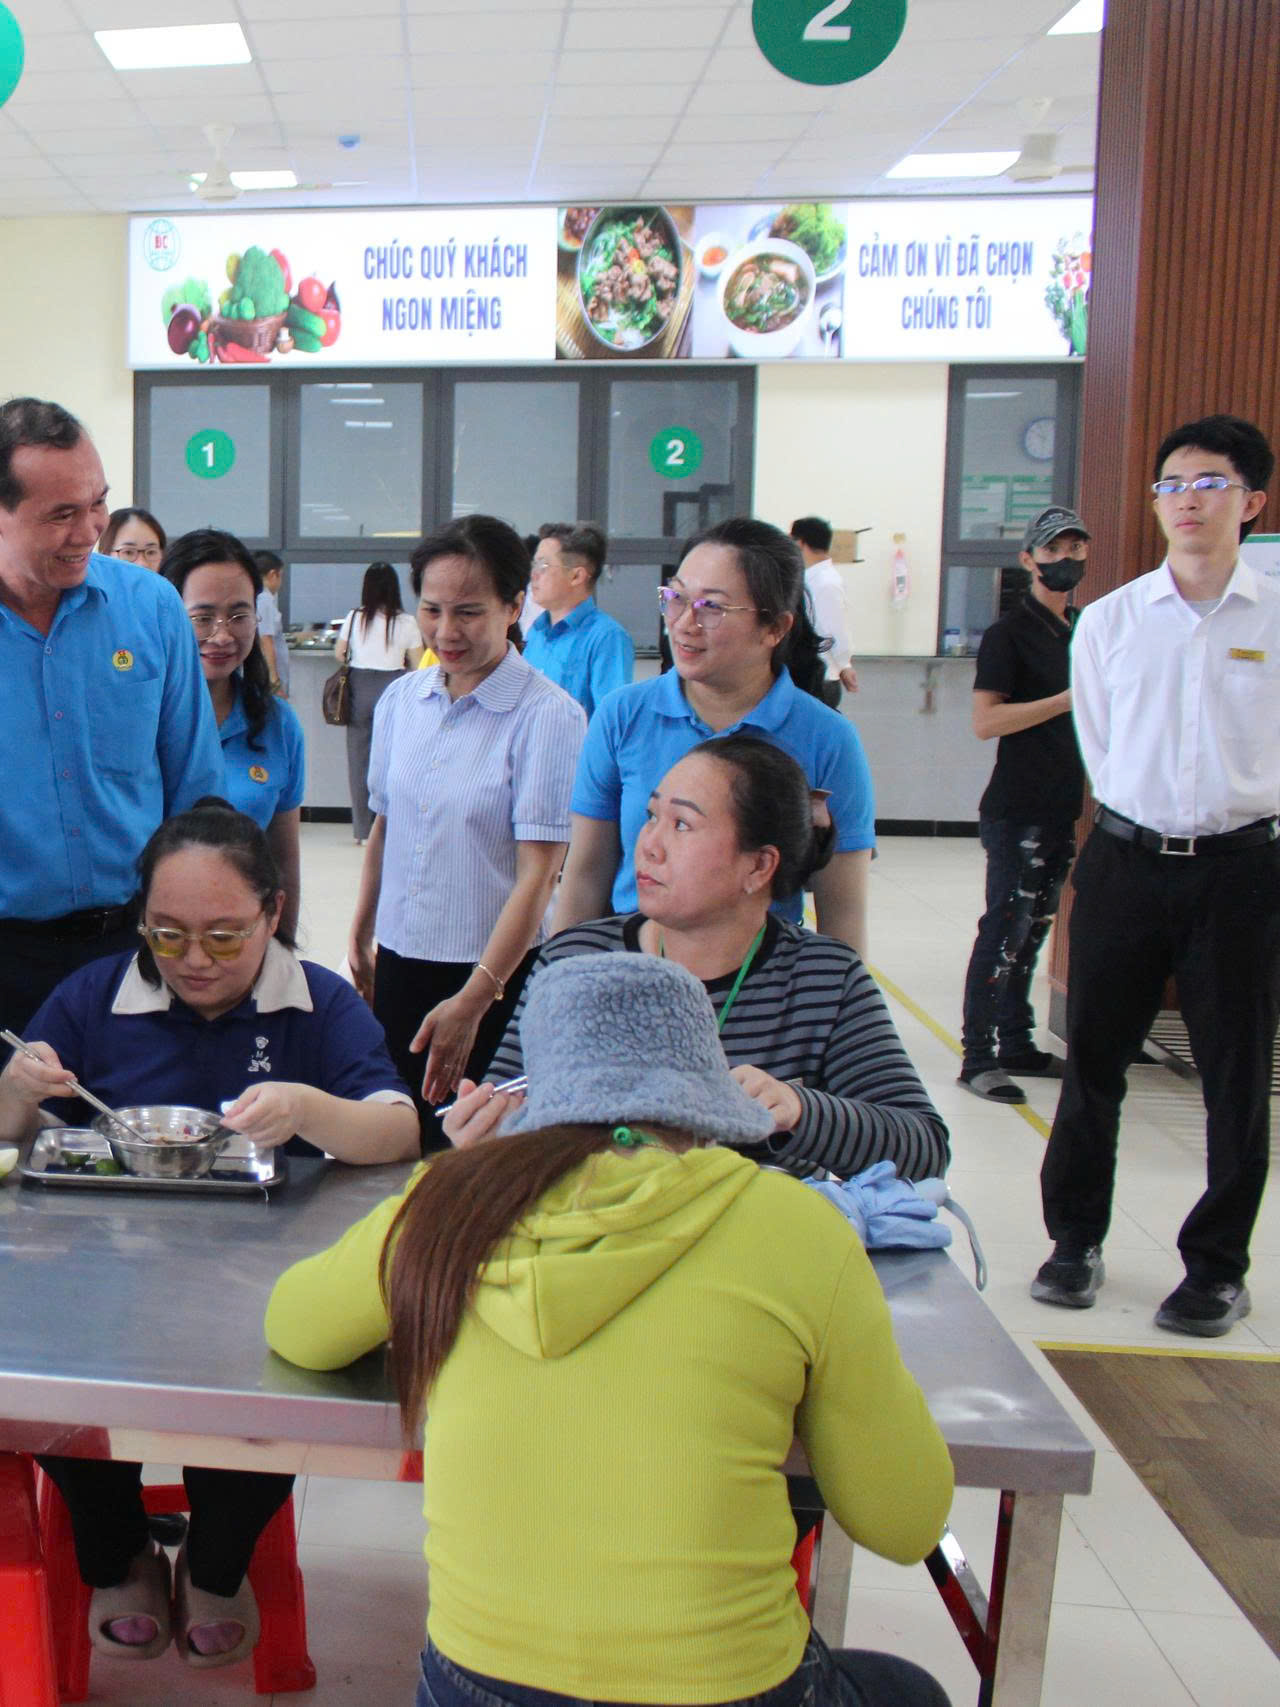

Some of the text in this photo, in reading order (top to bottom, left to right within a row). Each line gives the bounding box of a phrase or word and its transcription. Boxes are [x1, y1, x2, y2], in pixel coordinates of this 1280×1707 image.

[363, 236, 528, 280] CHÚC QUÝ KHÁCH
[858, 232, 1035, 284] CẢM ƠN VÌ ĐÃ CHỌN
[382, 288, 502, 337] NGON MIỆNG
[901, 285, 992, 330] CHÚNG TÔI
[201, 441, 215, 468] 1
[665, 438, 686, 466] 2
